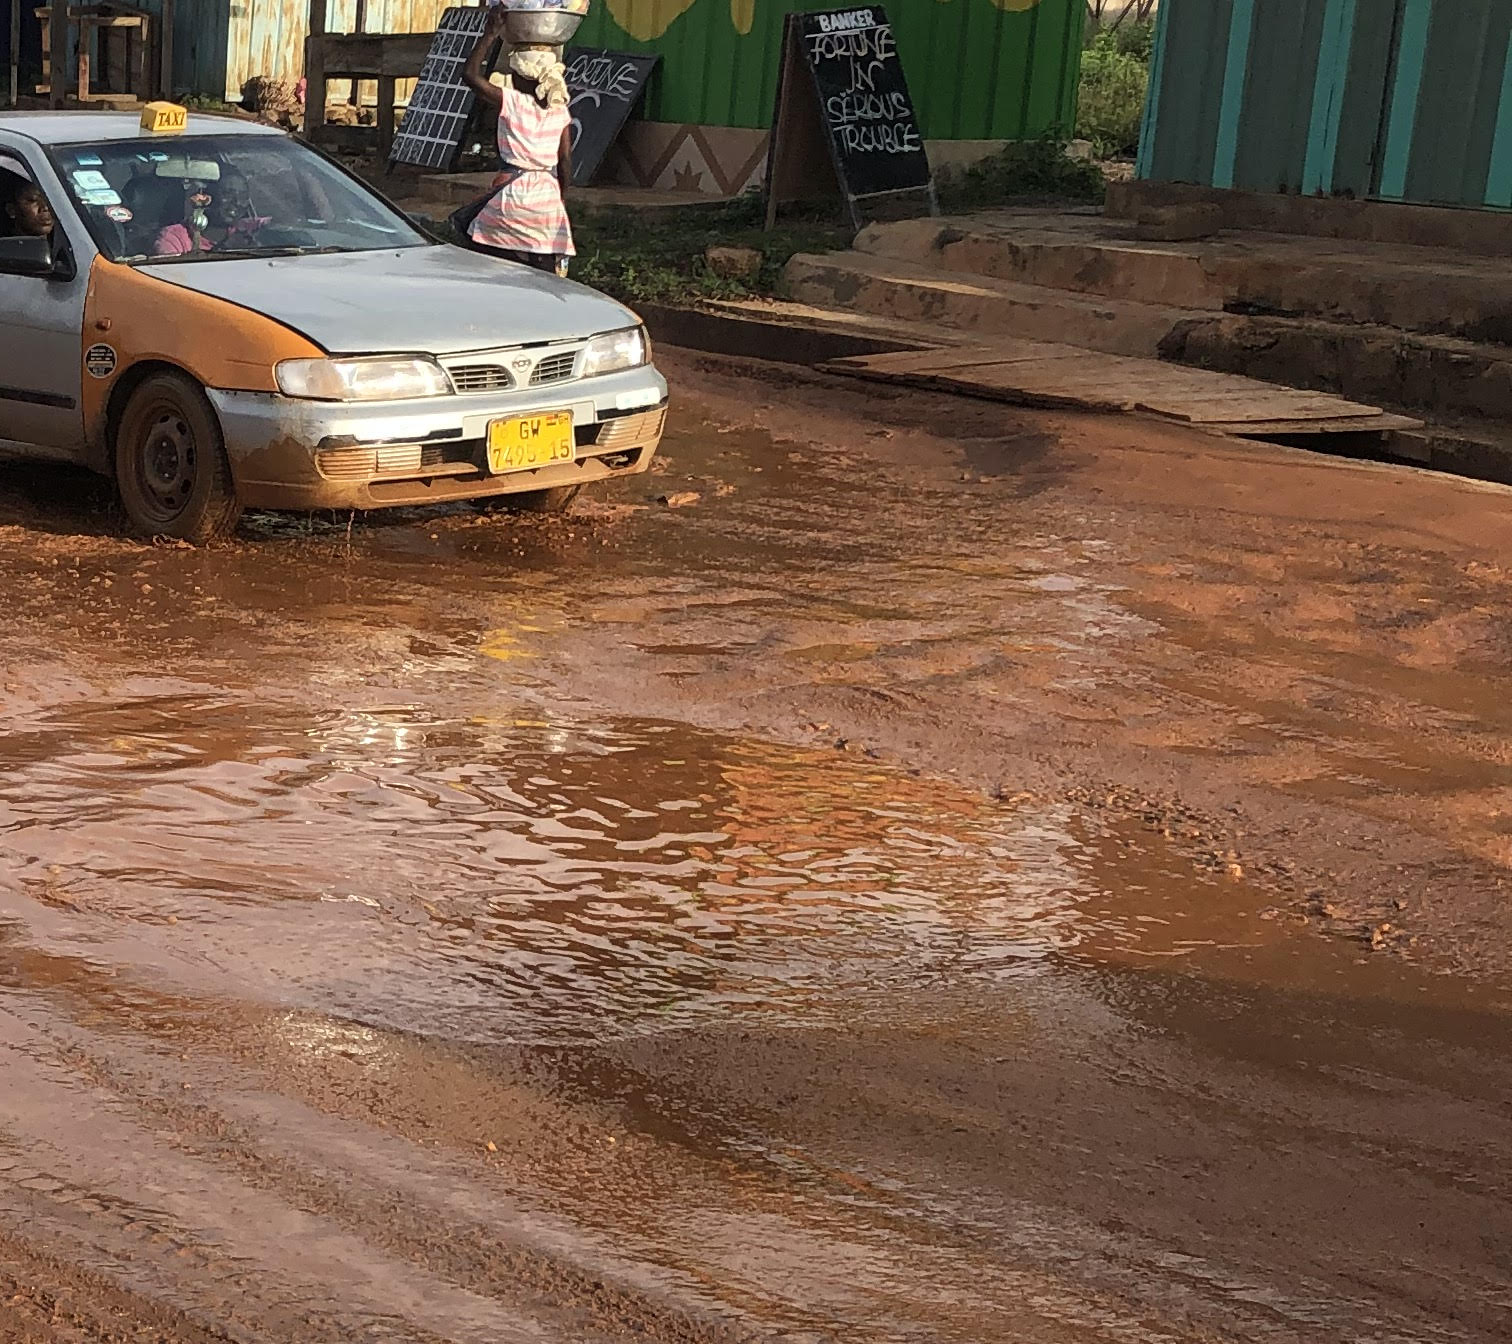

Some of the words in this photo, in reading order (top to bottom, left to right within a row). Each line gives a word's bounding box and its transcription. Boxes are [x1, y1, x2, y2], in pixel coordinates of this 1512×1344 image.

[810, 27, 896, 64] FORTUNE
[846, 56, 885, 93] IN
[159, 111, 186, 127] TAXI
[833, 123, 921, 154] TROUBLE
[520, 419, 541, 440] GW
